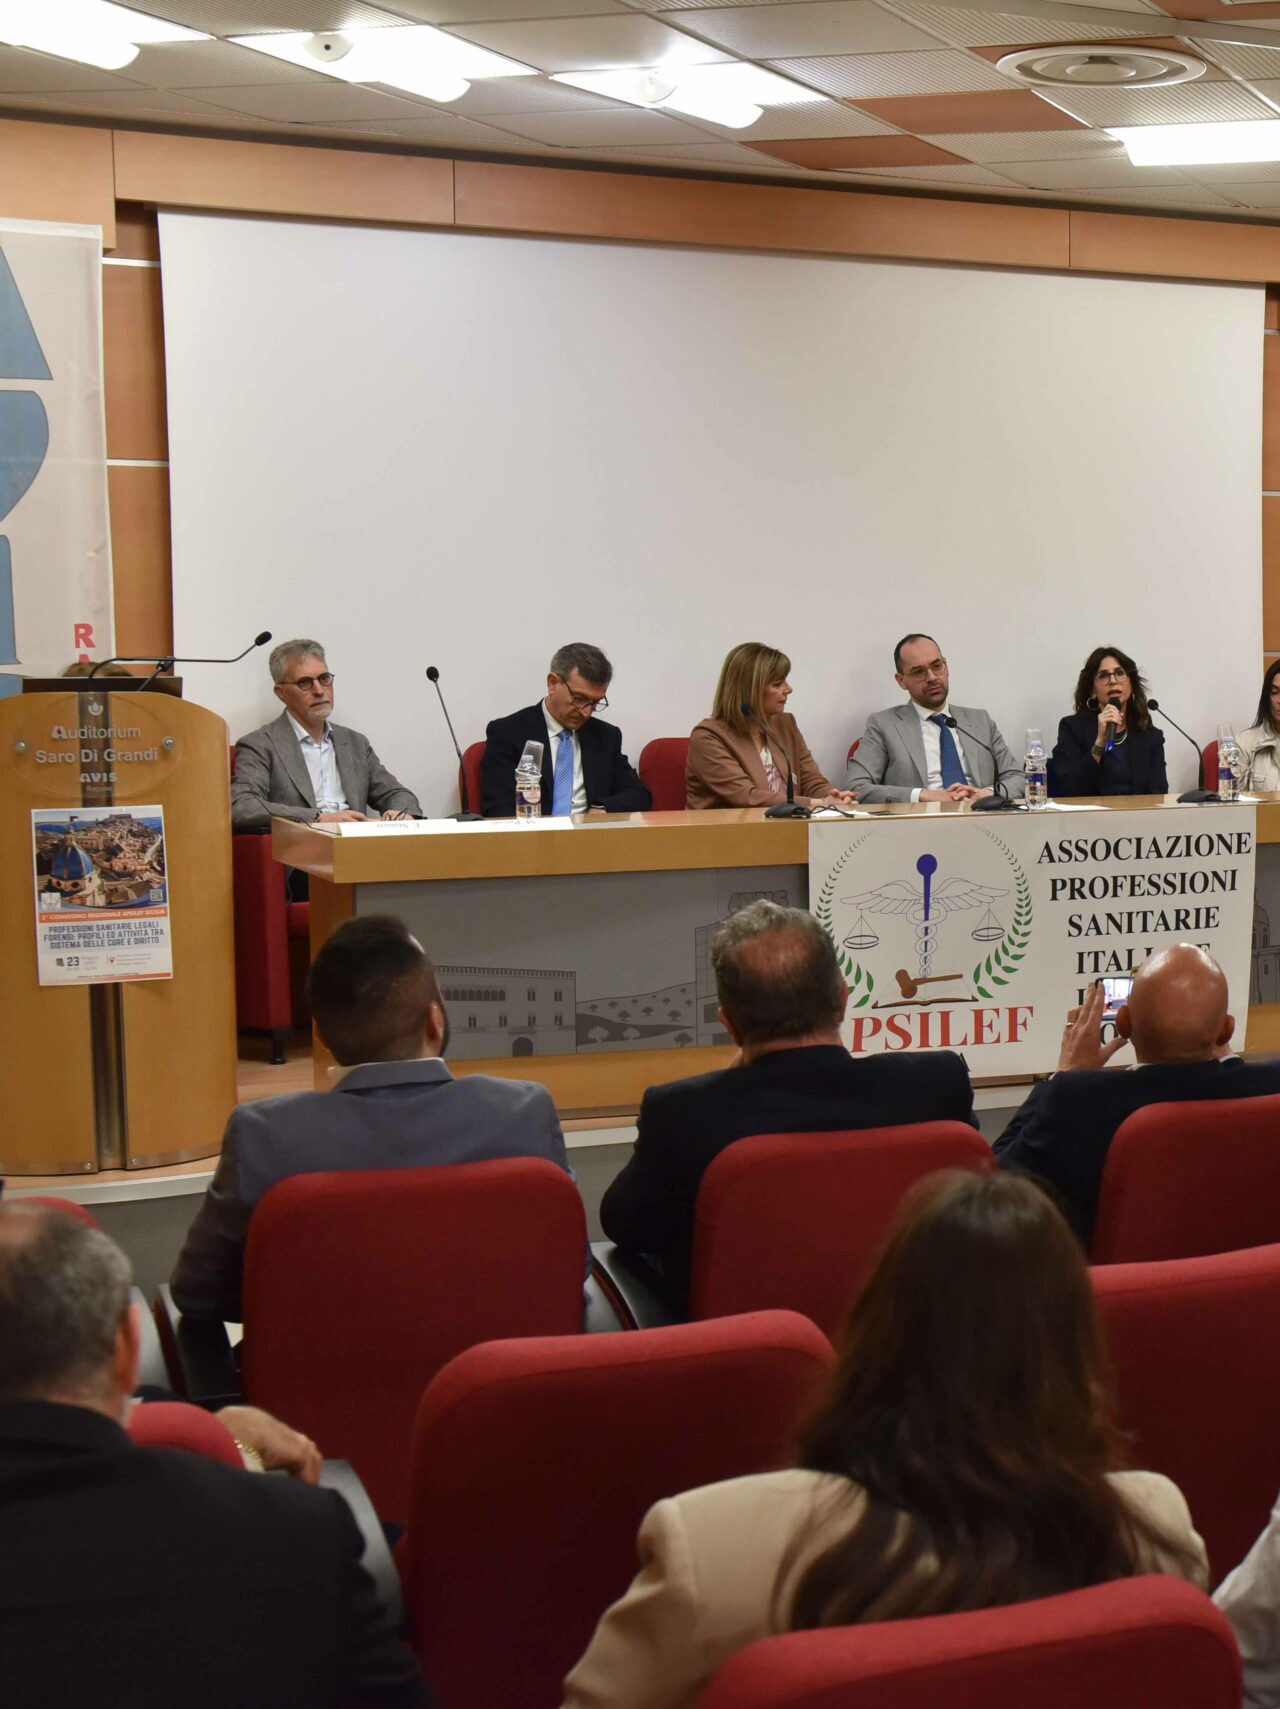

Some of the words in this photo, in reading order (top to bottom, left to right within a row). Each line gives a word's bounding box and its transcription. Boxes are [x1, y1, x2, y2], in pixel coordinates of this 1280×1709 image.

[35, 750, 75, 763] Saro
[81, 749, 99, 762] Di
[103, 747, 158, 762] Grandi
[1037, 832, 1252, 864] ASSOCIAZIONE
[1049, 869, 1239, 901] PROFESSIONI
[49, 925, 94, 933] PROFESSIONI
[95, 922, 132, 931] SANITARIE
[134, 920, 159, 929] LEGALI
[1067, 906, 1220, 938] SANITARIE
[78, 931, 105, 940] PROFILI
[106, 931, 116, 939] ED
[150, 928, 164, 936] TRA
[50, 940, 81, 949] SISTEMA
[83, 939, 105, 948] DELLE
[107, 938, 125, 947] CURE
[127, 937, 132, 946] E
[133, 936, 160, 945] DIRITTO
[67, 956, 80, 967] 23
